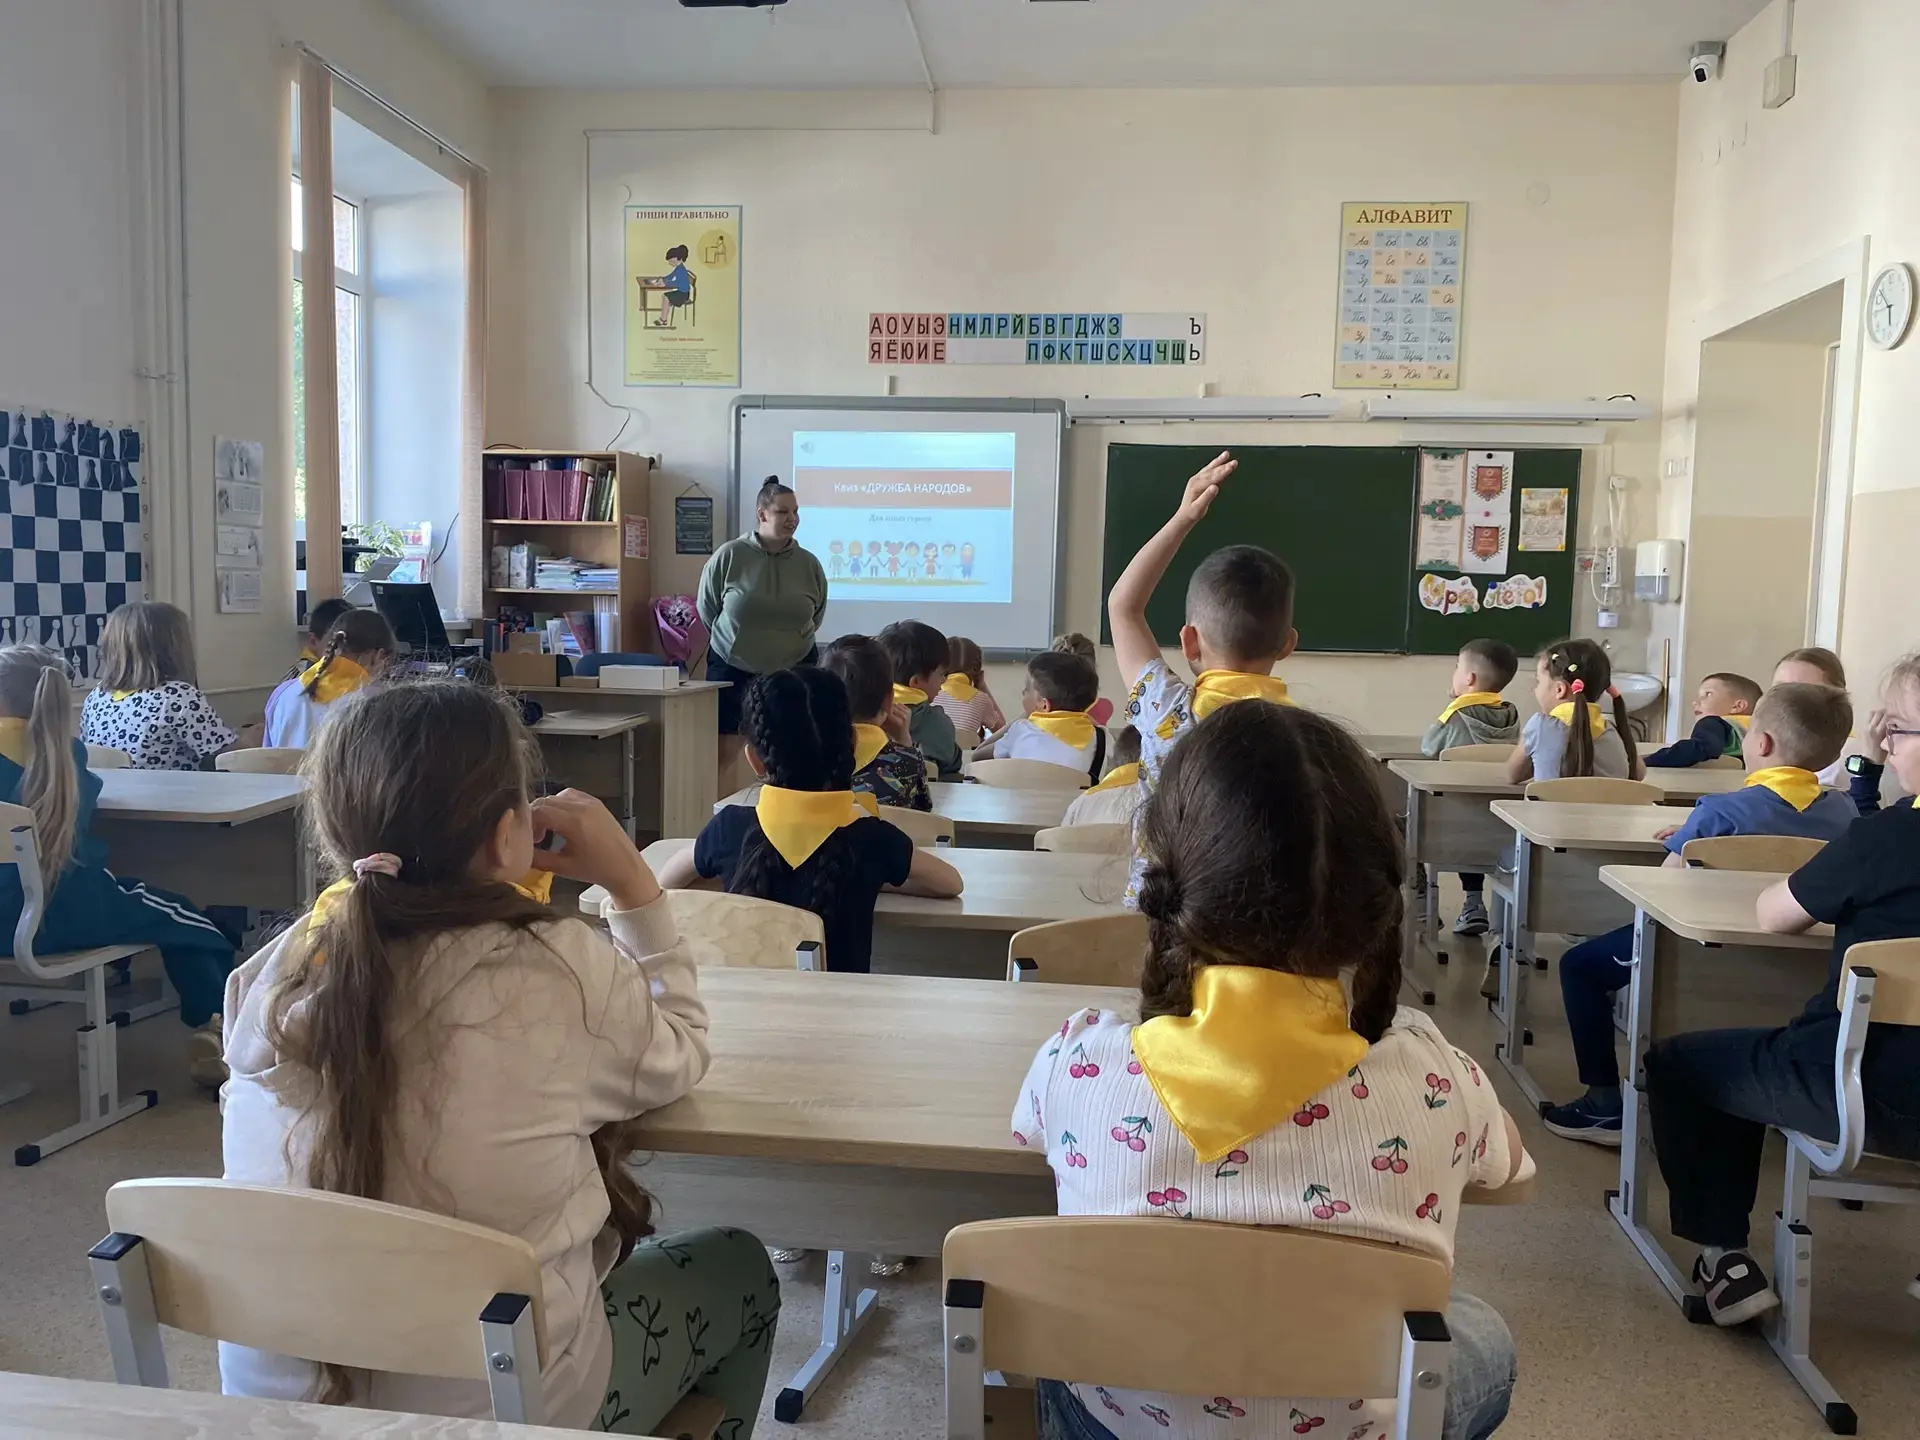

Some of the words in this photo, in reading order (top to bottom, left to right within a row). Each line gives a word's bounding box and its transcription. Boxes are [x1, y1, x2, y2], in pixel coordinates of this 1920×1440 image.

[636, 211, 668, 220] ПИШИ
[669, 211, 729, 220] ПРАВИЛЬНО
[1356, 210, 1452, 223] АЛФАВИТ
[1189, 317, 1201, 335] Ъ
[834, 482, 858, 493] Квиз
[861, 482, 911, 494] «ДРУЖБА
[914, 483, 972, 495] НАРОДОВ»
